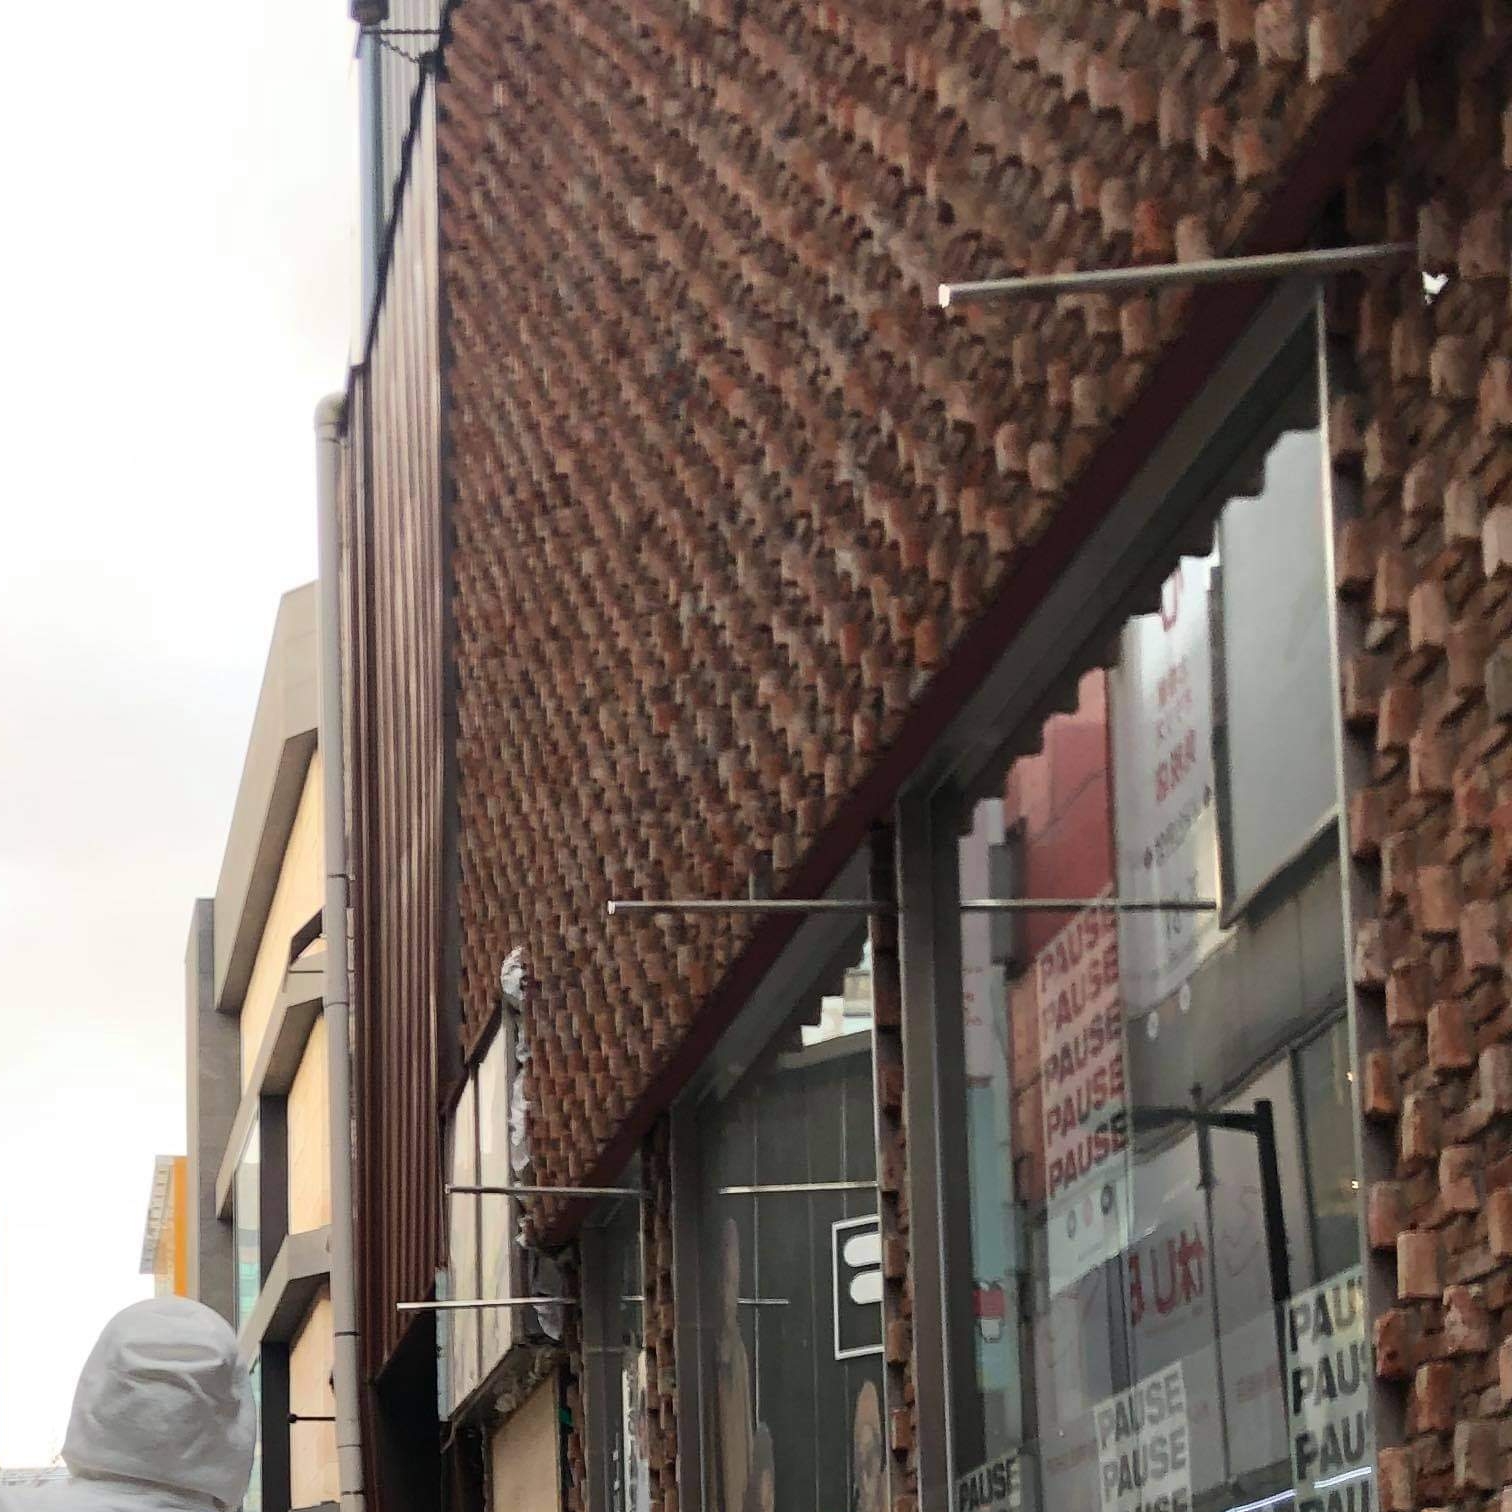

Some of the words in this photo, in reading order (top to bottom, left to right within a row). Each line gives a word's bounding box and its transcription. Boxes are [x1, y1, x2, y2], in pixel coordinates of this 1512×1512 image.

[1040, 900, 1118, 992] PAUSE
[1042, 944, 1119, 1040] PAUSE
[1044, 1001, 1122, 1096] PAUSE
[1048, 1054, 1125, 1148] PAUSE
[1049, 1108, 1129, 1200] PAUSE
[1290, 1276, 1362, 1352] PAU
[1097, 1369, 1183, 1448] PAUSE
[1292, 1343, 1367, 1416] PAU
[1103, 1425, 1187, 1502] PAUSE
[1295, 1412, 1366, 1481] PAU
